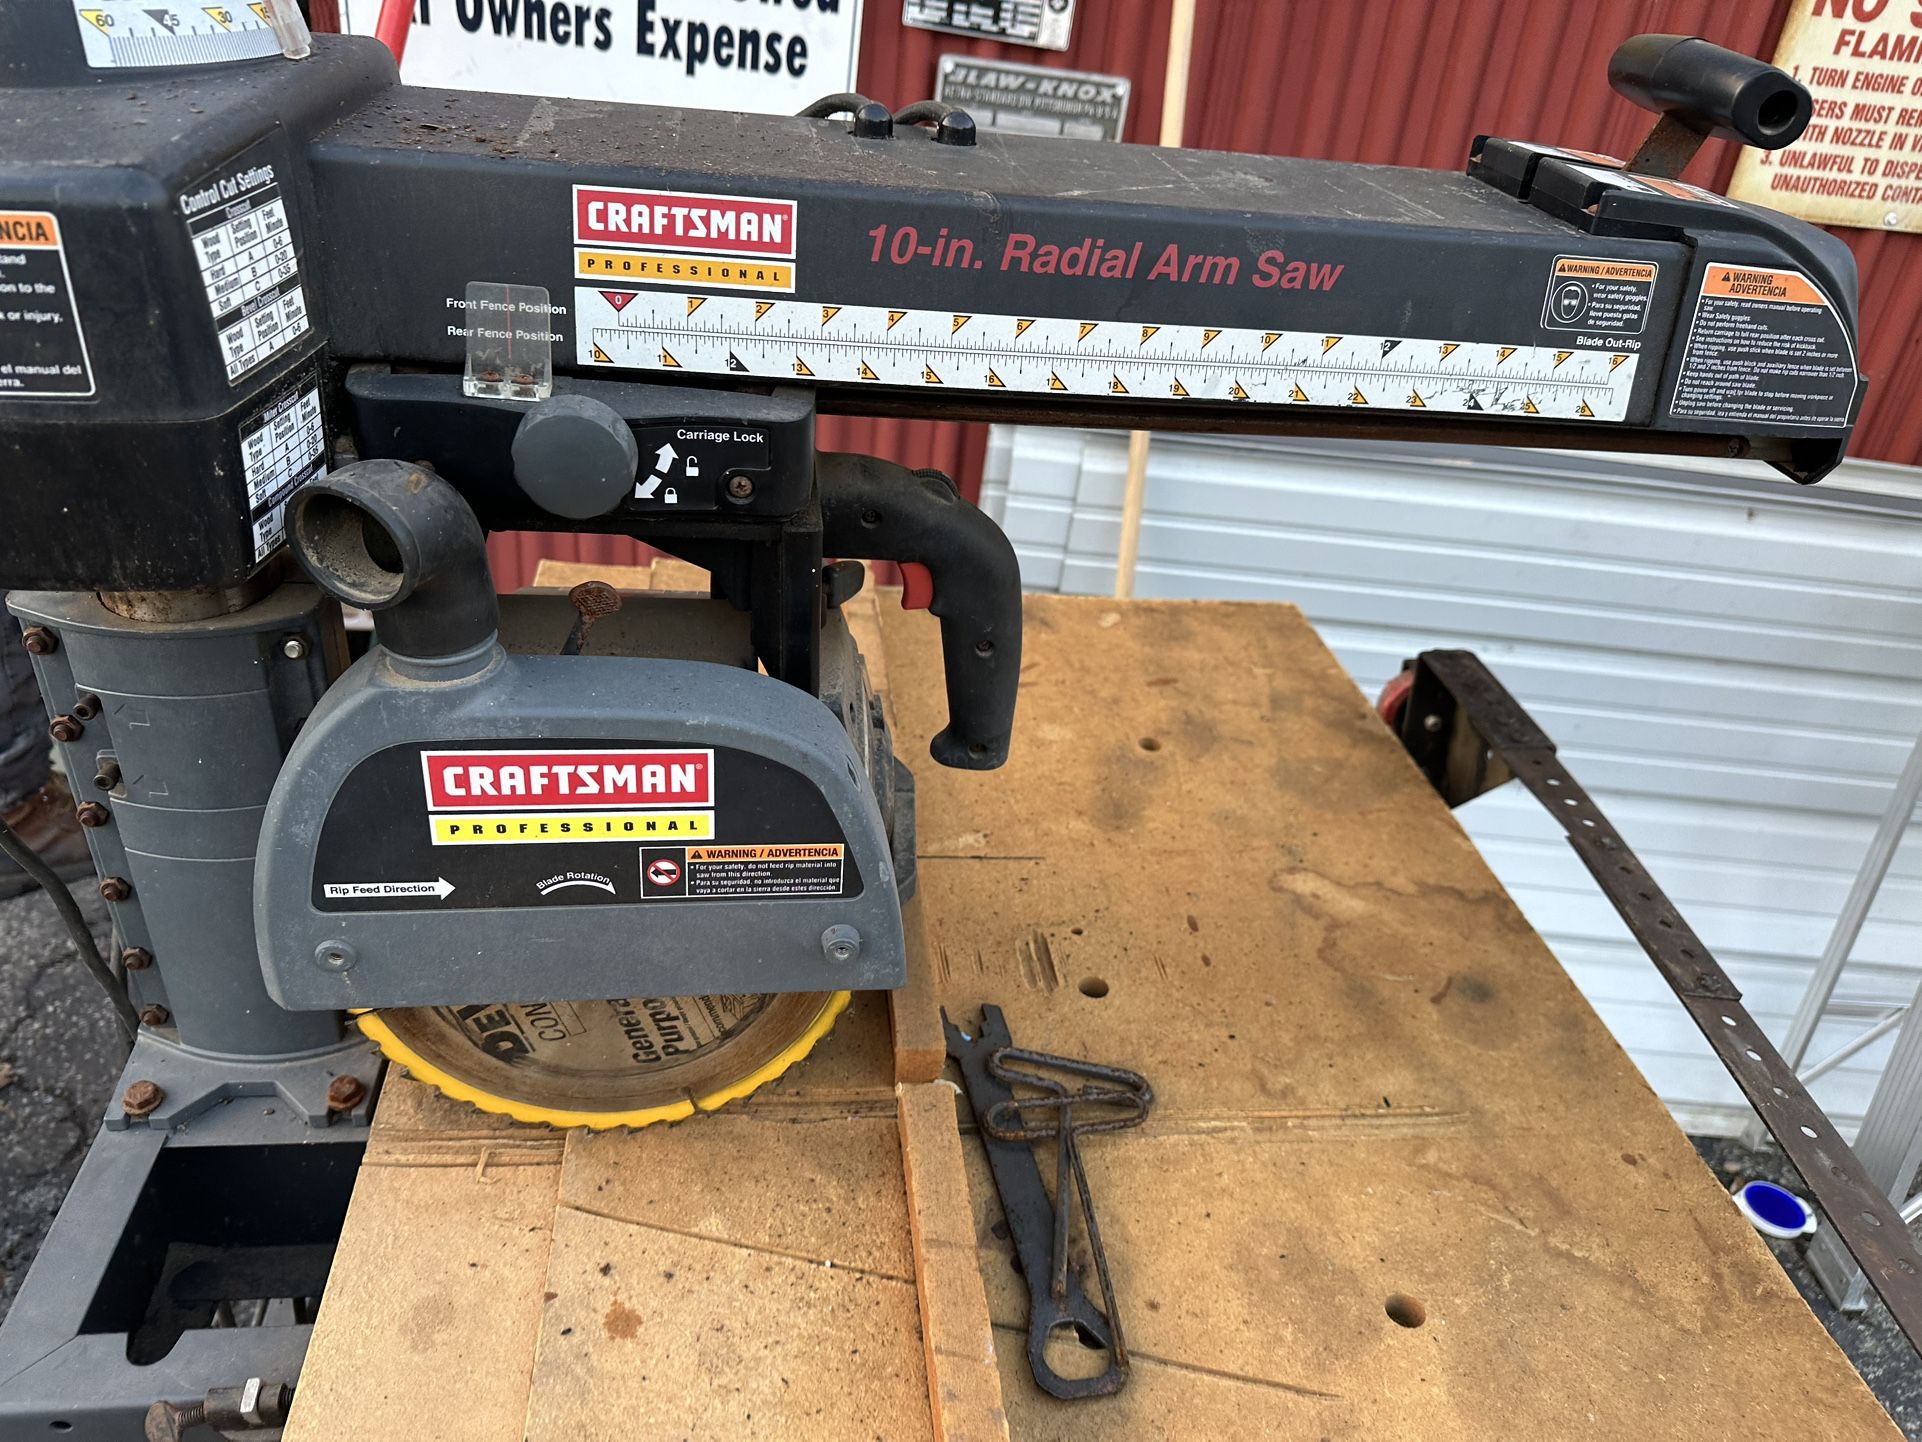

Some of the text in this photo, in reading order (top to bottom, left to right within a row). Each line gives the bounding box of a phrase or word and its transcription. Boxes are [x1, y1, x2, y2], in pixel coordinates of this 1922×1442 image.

[96, 11, 233, 28] 60 45 30
[456, 0, 807, 77] Owners Expense
[1809, 66, 1850, 88] TURN
[1851, 71, 1909, 94] ENGINE
[1812, 99, 1847, 120] SERS
[1850, 103, 1895, 124] MUST
[1830, 126, 1908, 151] NOZZLE IN
[1760, 151, 1772, 166] 3.
[1779, 149, 1854, 174] UNLAWFUL
[1861, 157, 1879, 176] TO
[180, 184, 220, 215] Control
[219, 177, 239, 199] Cut
[236, 164, 274, 192] Settings
[1771, 173, 1878, 200] UNAUTHORIZED
[588, 201, 782, 243] CRAFTSMAN
[866, 224, 1344, 291] 10-in. Radial Arm Saw
[587, 258, 780, 282] PROFESSIONAL
[1567, 264, 1653, 278] WARNING ADVERTENCIA
[1733, 272, 1773, 285] WARNING
[1729, 283, 1787, 297] ADVERTENCIA
[446, 298, 567, 314] Front Fence Position
[447, 326, 564, 342] Rear Fence Position
[614, 295, 623, 305] 0
[687, 300, 694, 309] 1
[755, 304, 763, 314] 2
[822, 309, 829, 319] 3
[888, 313, 895, 323] 4
[953, 318, 960, 327] 5
[1016, 322, 1023, 331] 6
[1079, 325, 1087, 334] 7
[1141, 329, 1149, 338] 8
[1203, 332, 1210, 341] 9
[1260, 335, 1271, 345] 10
[1321, 338, 1330, 347] 11
[1380, 341, 1391, 351] 12
[1495, 349, 1505, 358] 14
[1552, 353, 1562, 362] 15
[1608, 357, 1618, 366] 16
[1576, 336, 1641, 351] Blade Out-Rip
[588, 349, 601, 359] 10
[657, 353, 669, 364] 11
[724, 358, 737, 368] 12
[791, 362, 803, 372] 13
[857, 367, 868, 376] 14
[921, 370, 931, 380] 15
[983, 374, 995, 384] 16
[1046, 378, 1057, 387] 17
[1107, 381, 1118, 390] 18
[1169, 384, 1179, 393] 19
[1229, 387, 1240, 396] 20
[1288, 389, 1299, 398] 21
[1347, 392, 1359, 401] 22
[1406, 395, 1417, 404] 23
[1575, 405, 1586, 414] 26
[676, 429, 764, 443] Carriage Lock
[253, 469, 275, 491] Medium
[442, 763, 698, 796] CRAFTSMAN
[449, 820, 698, 836] PROFESSIONAL
[706, 849, 757, 858] WARNING
[767, 847, 838, 858] ADVERTENCIA
[330, 884, 435, 896] Rip Feed Direction
[536, 871, 610, 890] Blade Rotation
[456, 1004, 530, 1064] DE
